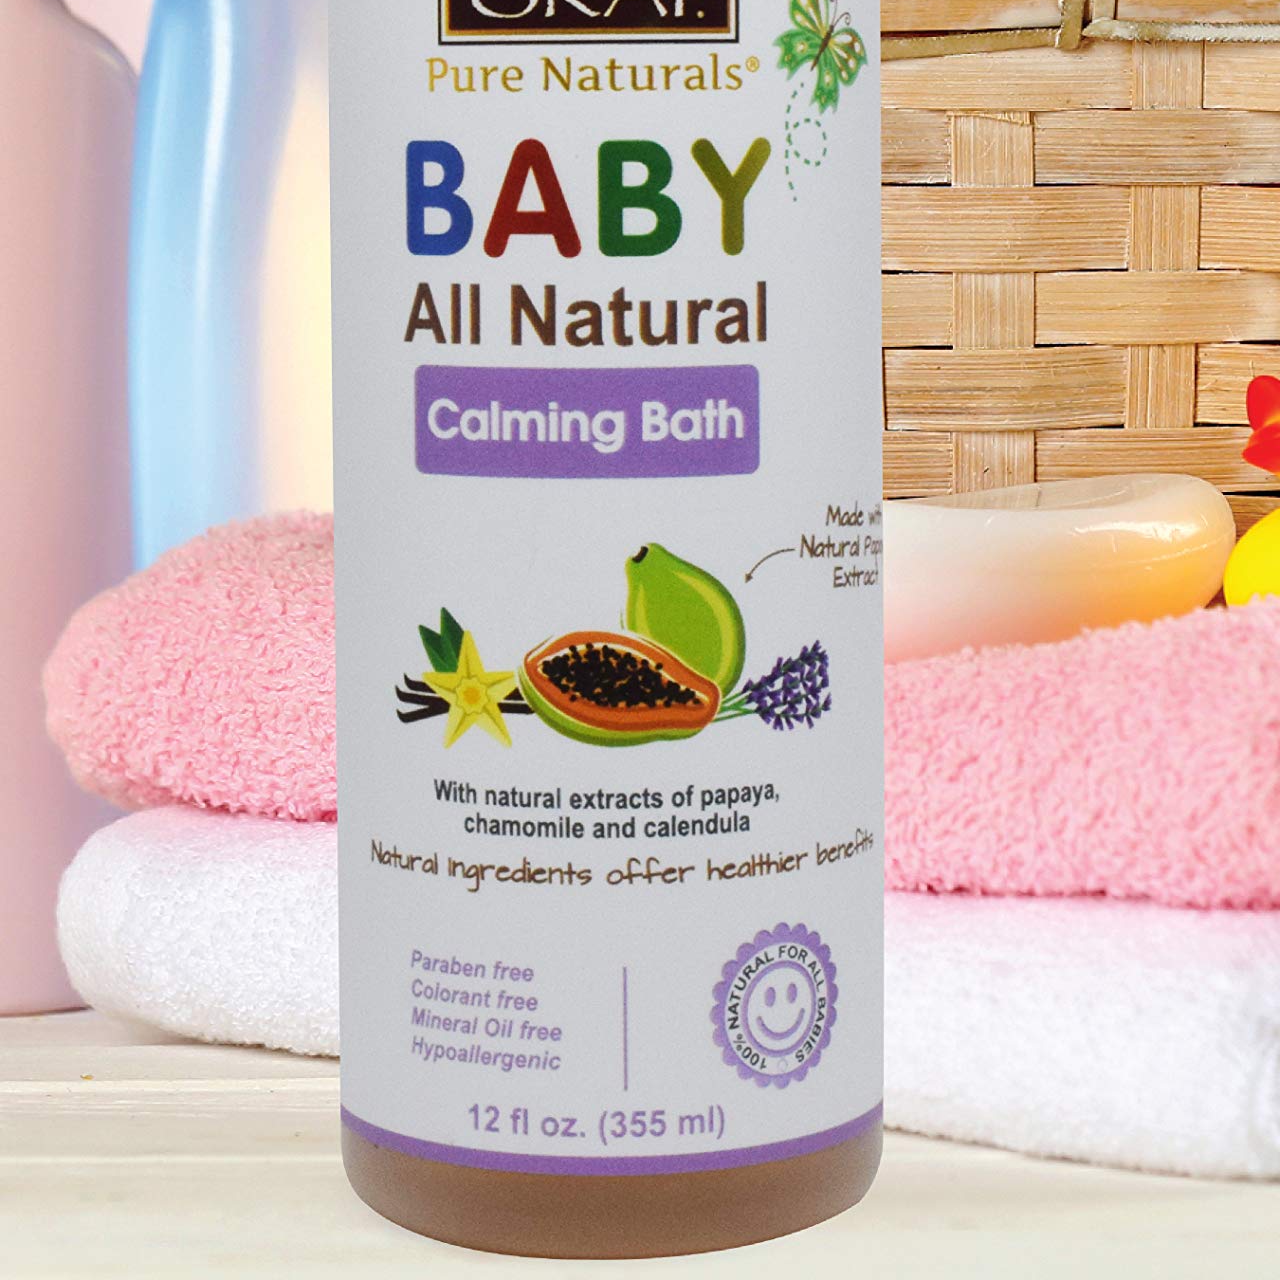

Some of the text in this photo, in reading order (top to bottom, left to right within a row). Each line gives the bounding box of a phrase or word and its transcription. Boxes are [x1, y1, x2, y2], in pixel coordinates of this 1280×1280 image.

[426, 57, 523, 93] Pure
[406, 137, 771, 258] BABY
[404, 281, 767, 347] All Natural
[428, 398, 745, 454] Calming Bath
[826, 500, 864, 526] Made
[800, 534, 860, 558] Natural
[434, 779, 779, 811] With natural extracts of papaya,
[464, 811, 750, 839] chamomile and calendula
[371, 840, 438, 875] Natural
[606, 857, 695, 885] offer
[707, 852, 808, 880] healthier
[816, 828, 873, 865] benefits
[411, 949, 534, 982] Paraben free
[412, 978, 538, 1011] Colorant free
[728, 945, 827, 1070] 100% NATURAL FOR ALL BABIES
[412, 1006, 562, 1041] Mineral Oil free
[412, 1035, 562, 1072] Hypoallergenic
[469, 1104, 725, 1146] 12 fl oz. (355 ml)
